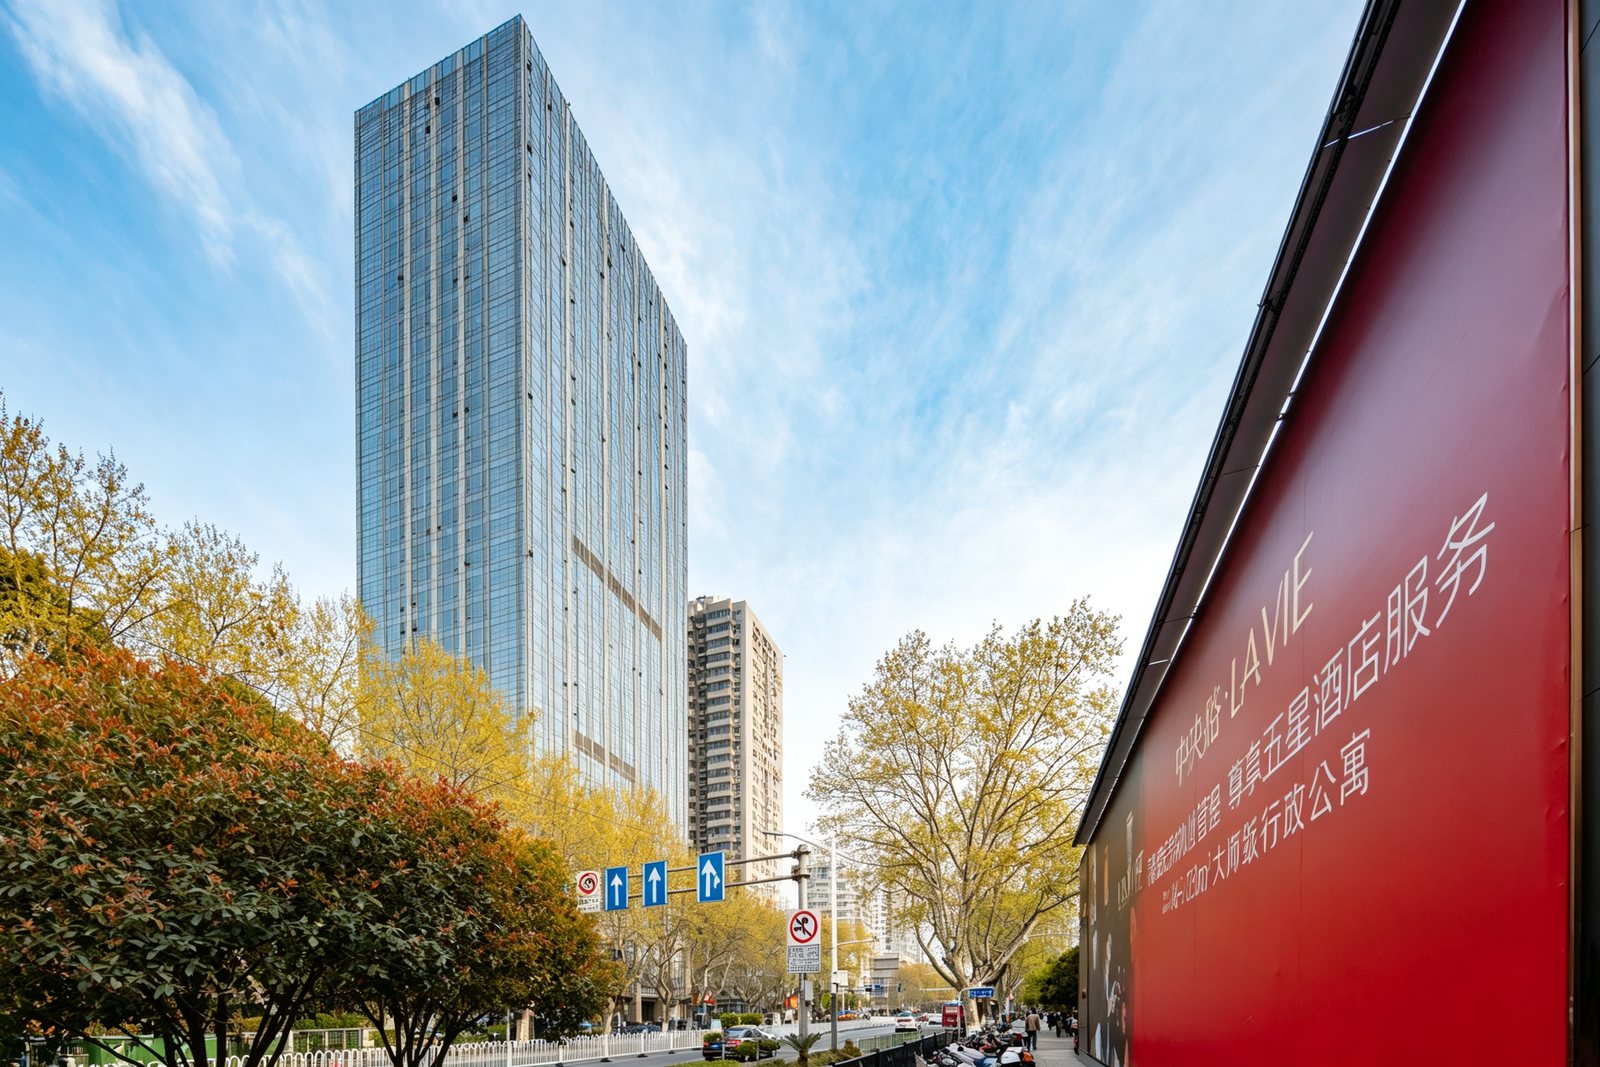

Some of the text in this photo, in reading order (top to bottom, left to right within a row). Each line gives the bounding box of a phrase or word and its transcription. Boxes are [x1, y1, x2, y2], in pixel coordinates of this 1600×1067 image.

[1227, 491, 1496, 811] 尊享五星酒店服务
